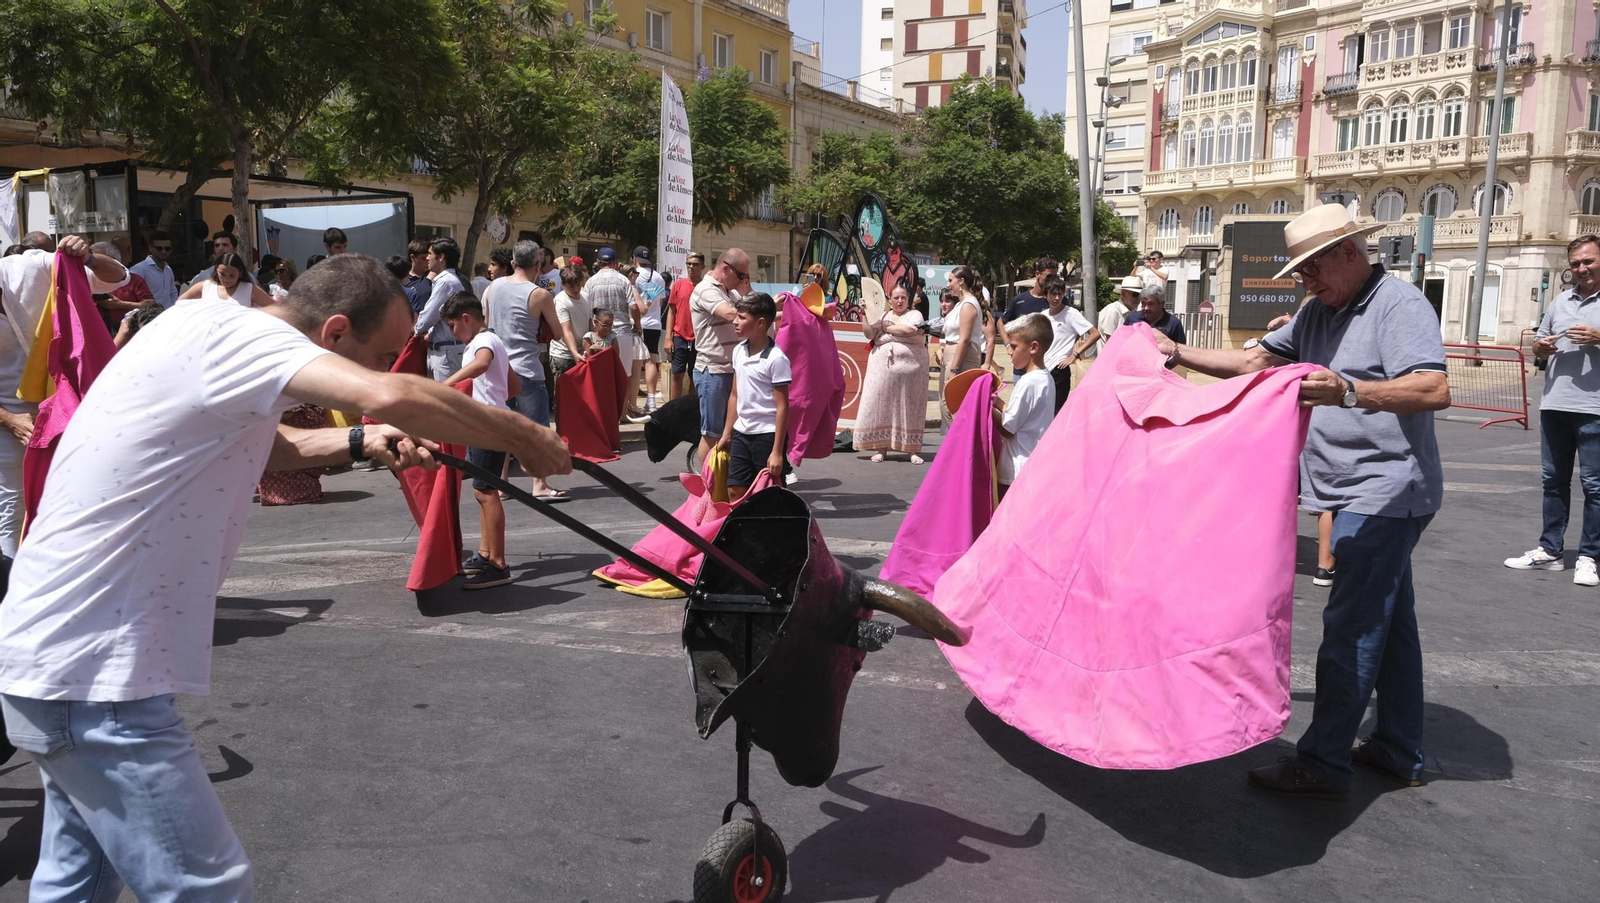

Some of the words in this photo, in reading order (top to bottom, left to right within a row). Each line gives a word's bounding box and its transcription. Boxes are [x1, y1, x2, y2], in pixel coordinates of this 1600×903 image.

[1242, 254, 1291, 263] Soportex
[1240, 294, 1257, 303] 950
[1259, 294, 1276, 303] 680
[1278, 294, 1296, 303] 870
